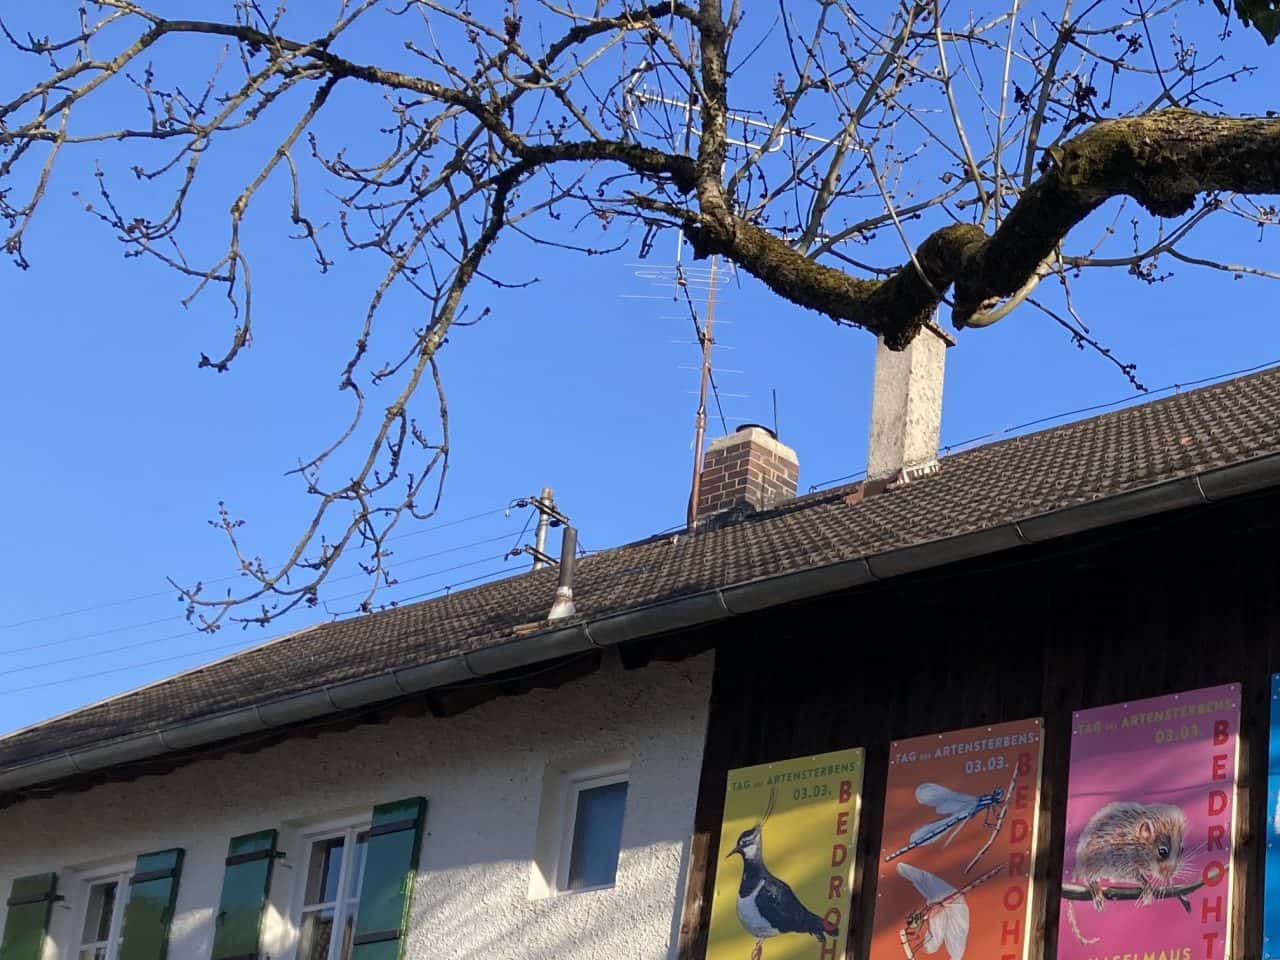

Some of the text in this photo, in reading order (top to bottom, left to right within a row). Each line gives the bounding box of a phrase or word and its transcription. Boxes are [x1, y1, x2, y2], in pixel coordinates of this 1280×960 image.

[896, 752, 917, 764] TAG
[934, 733, 1034, 758] ARTENSTERBENS
[732, 781, 751, 792] TAG
[767, 762, 856, 785] ARTENSTERBENS
[965, 756, 1009, 774] 03.03.
[793, 785, 832, 801] 03.03.
[1201, 720, 1230, 960] BEDROHT
